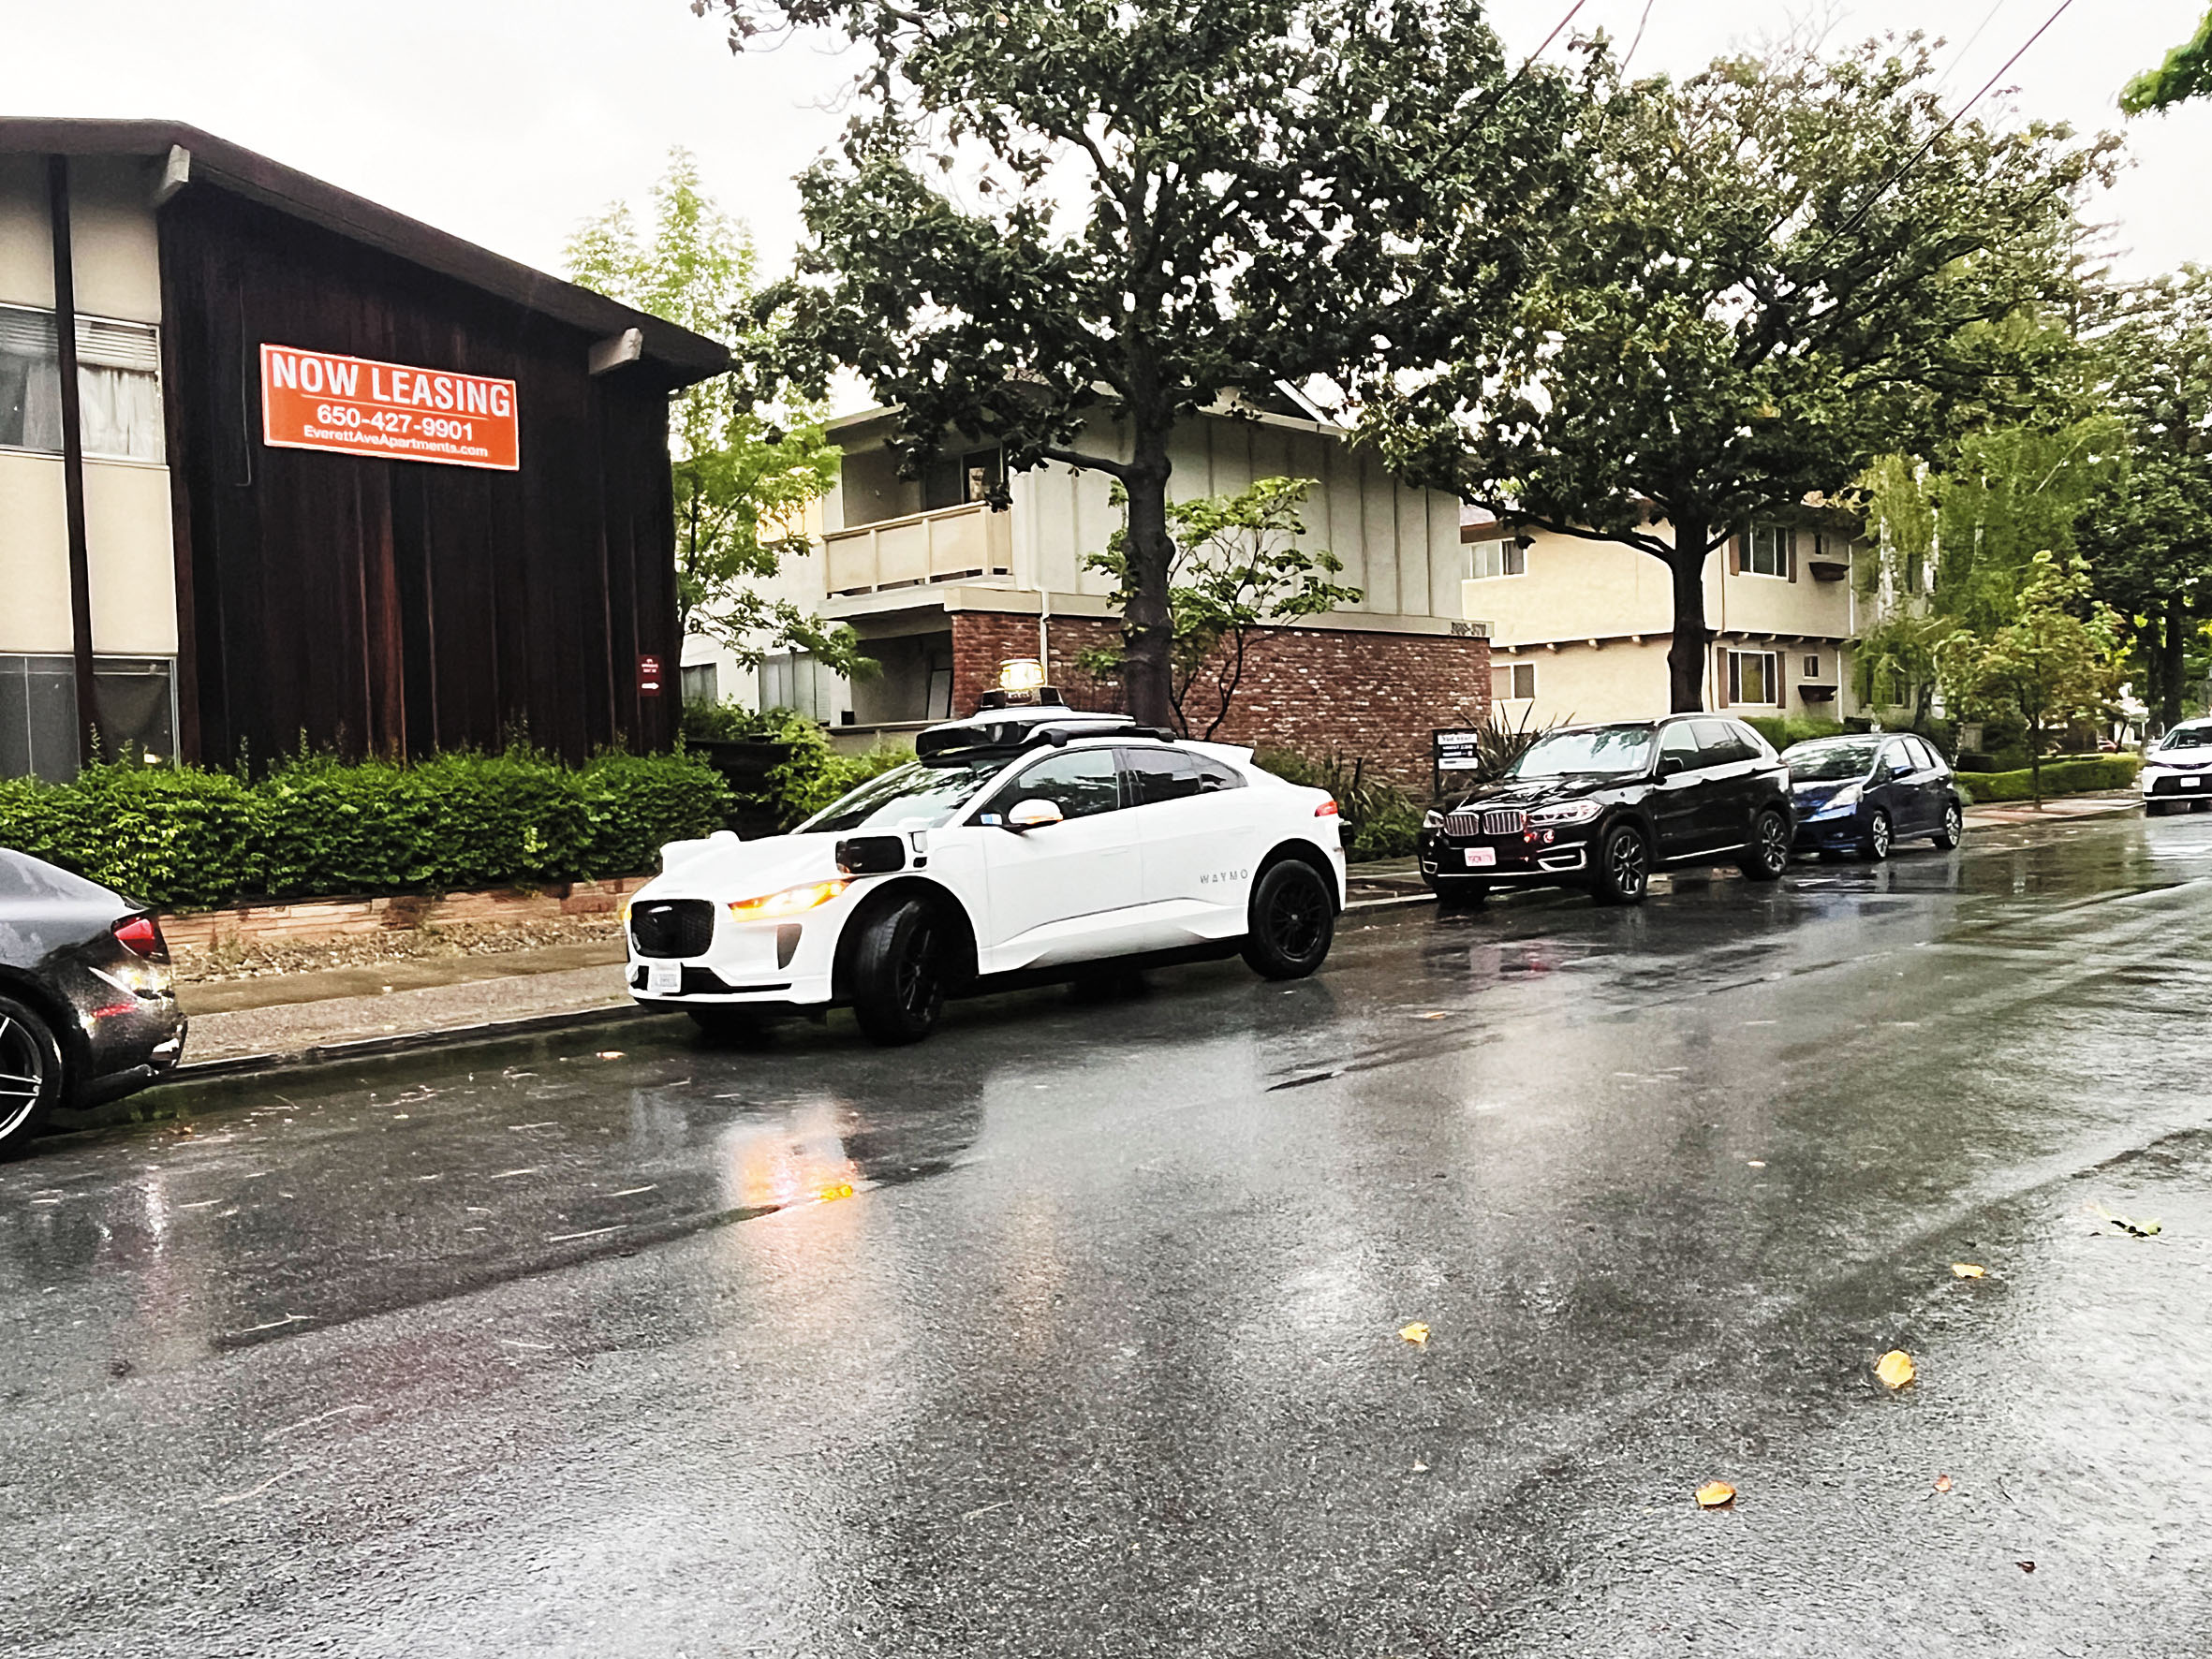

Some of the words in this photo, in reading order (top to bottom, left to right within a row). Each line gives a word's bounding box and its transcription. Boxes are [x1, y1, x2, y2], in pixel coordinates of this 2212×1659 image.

[272, 352, 360, 397] NOW
[372, 366, 510, 417] LEASING
[317, 404, 473, 441] 650-427-9901
[303, 424, 489, 457] EverettAveApartments.com
[1200, 869, 1248, 884] WAYMO
